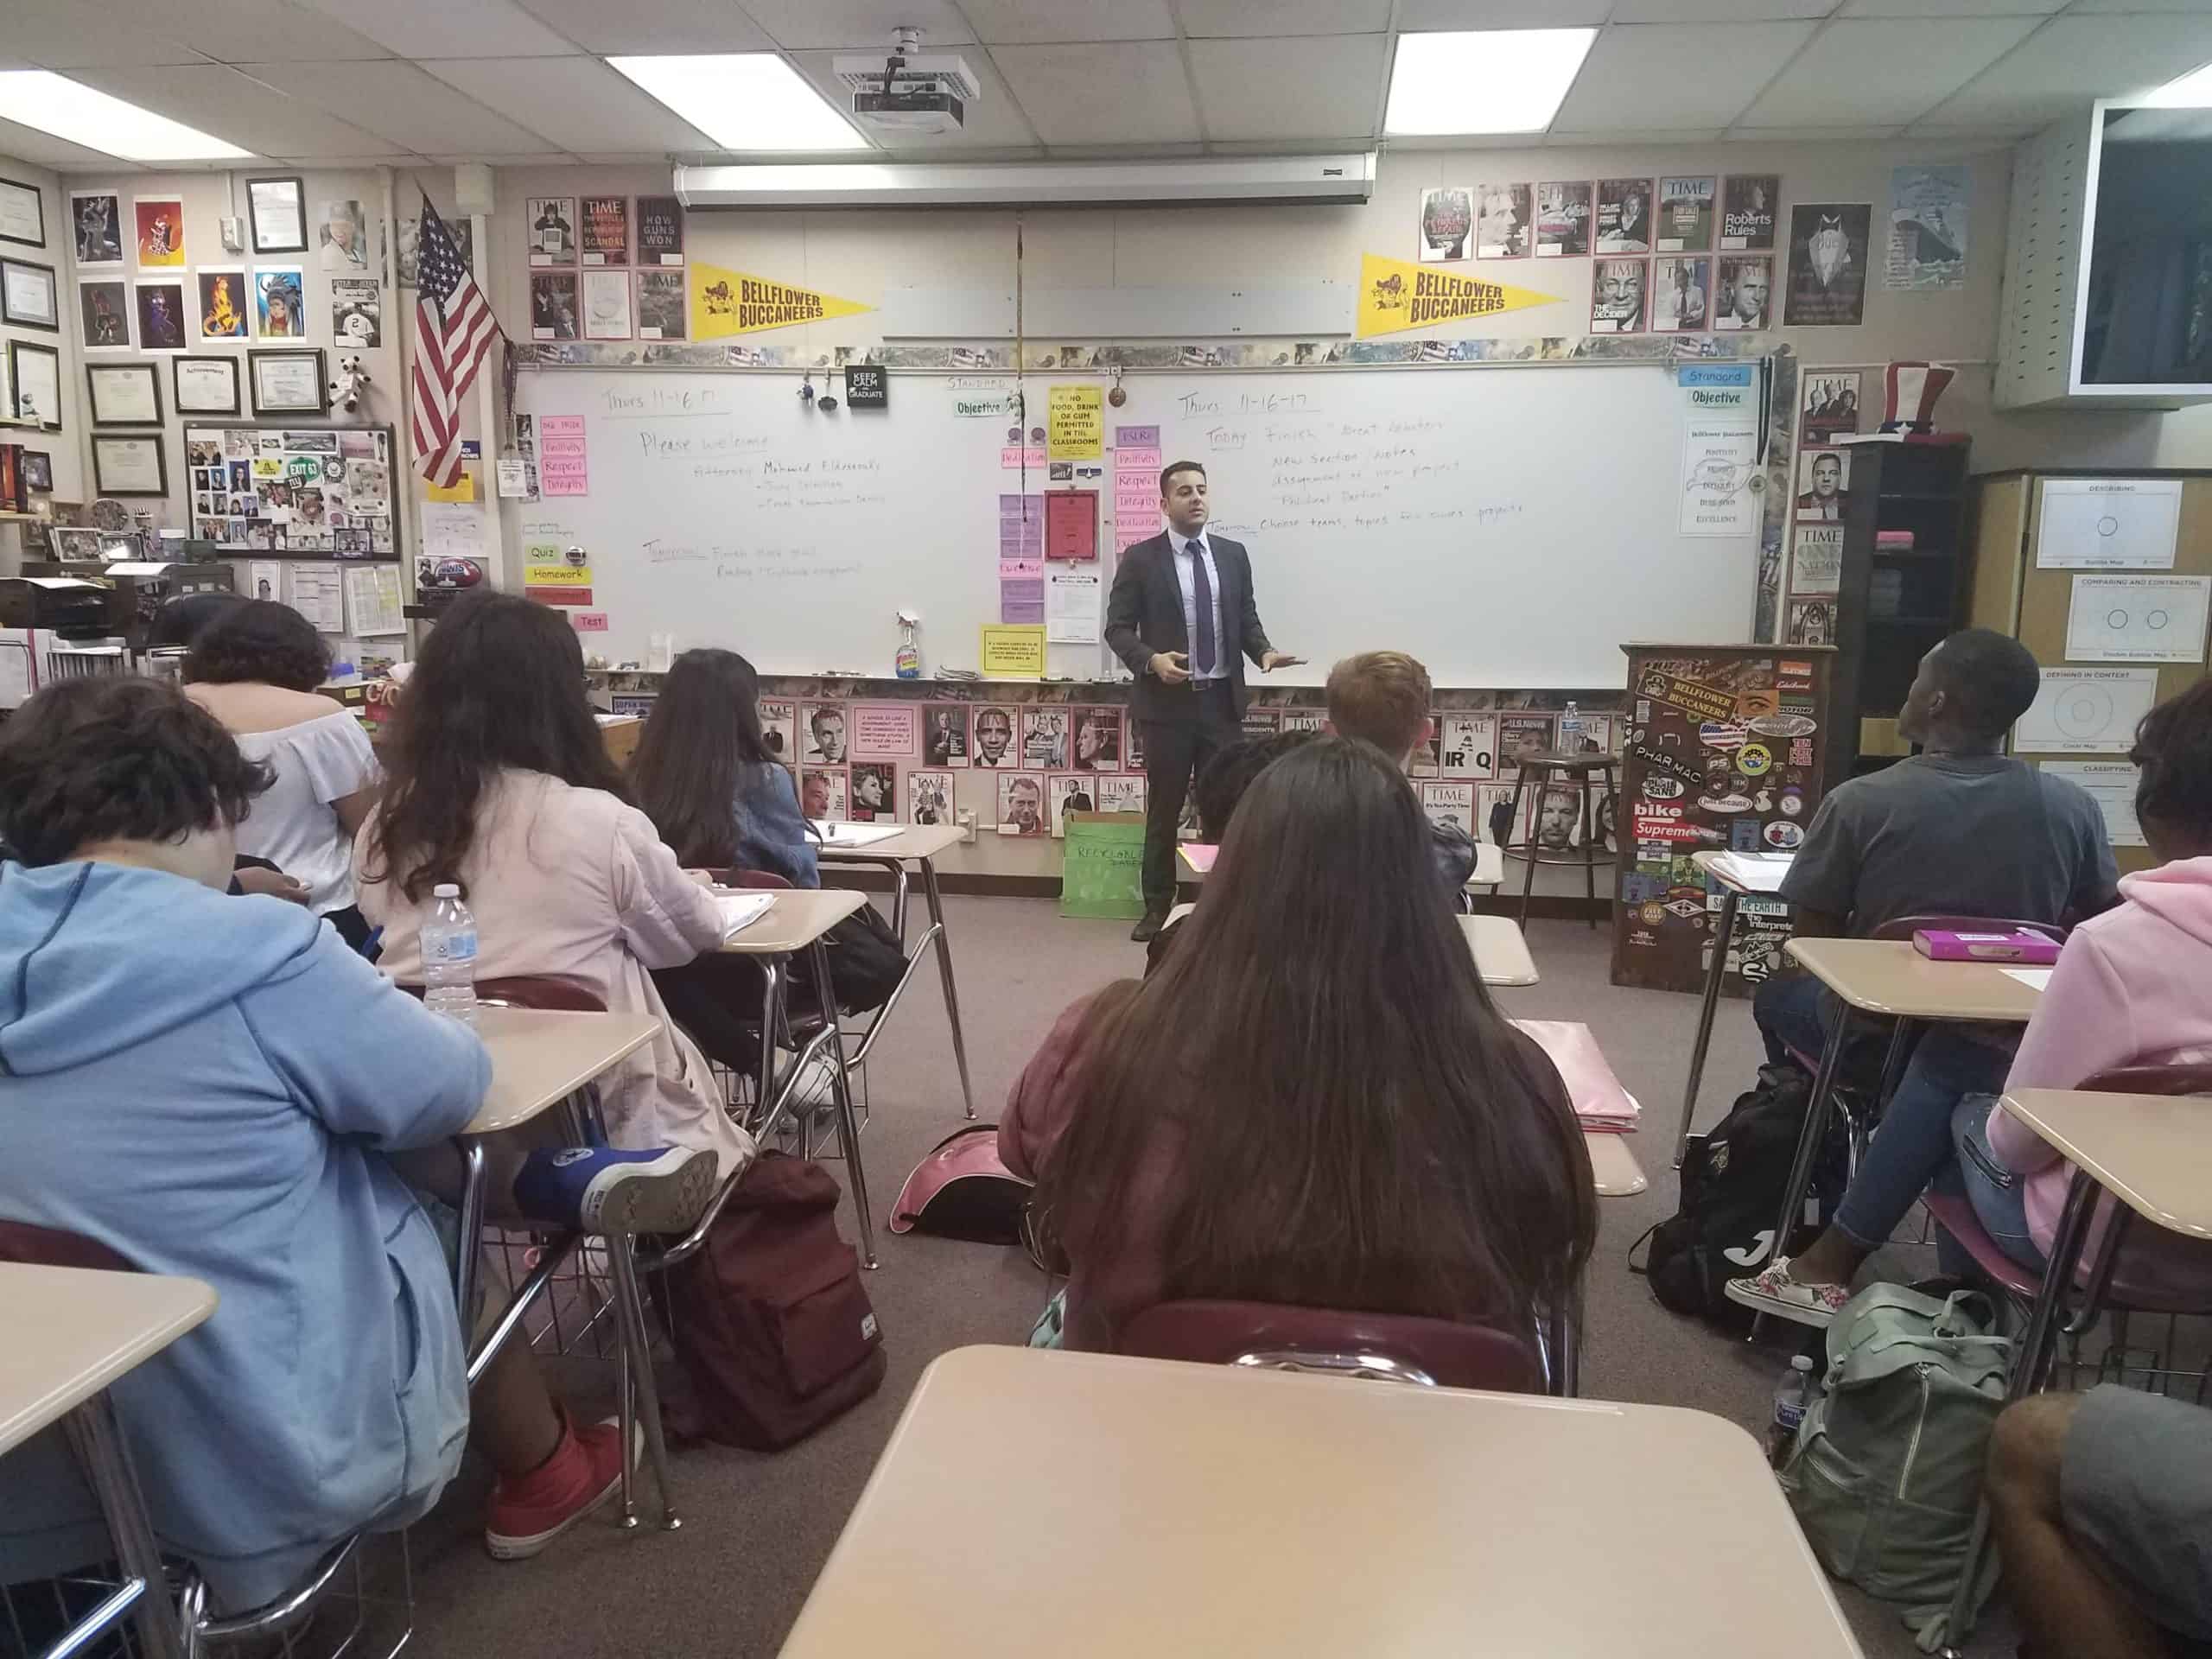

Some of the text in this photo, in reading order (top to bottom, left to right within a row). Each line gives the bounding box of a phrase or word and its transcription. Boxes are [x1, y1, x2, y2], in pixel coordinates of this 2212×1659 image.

[1669, 181, 1707, 194] TIME
[588, 201, 622, 213] TIME
[646, 216, 671, 225] HOW
[1726, 214, 1771, 225] Roberts
[643, 226, 675, 235] GUNS
[1725, 225, 1757, 236] Rules
[585, 238, 625, 247] SCANDAL
[646, 236, 673, 245] WON
[1415, 271, 1502, 298] BELLFLOWER
[741, 279, 820, 306] BELLFLOWER
[739, 304, 823, 328] BUCCANEERS
[1410, 298, 1505, 323] BUCCANEERS
[1593, 310, 1628, 319] DECIDER
[852, 372, 878, 381] KEEP
[849, 391, 884, 399] GRADUATE
[1692, 390, 1742, 404] Objective
[957, 402, 1001, 415] Objective
[289, 463, 306, 475] EXIT
[545, 461, 582, 475] Respect
[1118, 474, 1157, 489] Respect
[1804, 531, 1841, 543] TIME
[531, 547, 554, 561] Quiz
[533, 568, 583, 581] Homework
[581, 616, 603, 626] Test
[1673, 681, 1732, 707] BELLFLOWER
[1668, 694, 1727, 720] BUCCANEERS
[1476, 752, 1492, 770] Q
[1058, 781, 1086, 791] TIE
[1107, 782, 1135, 793] TIME
[1433, 790, 1466, 801] TIME
[1634, 804, 1682, 817] bike
